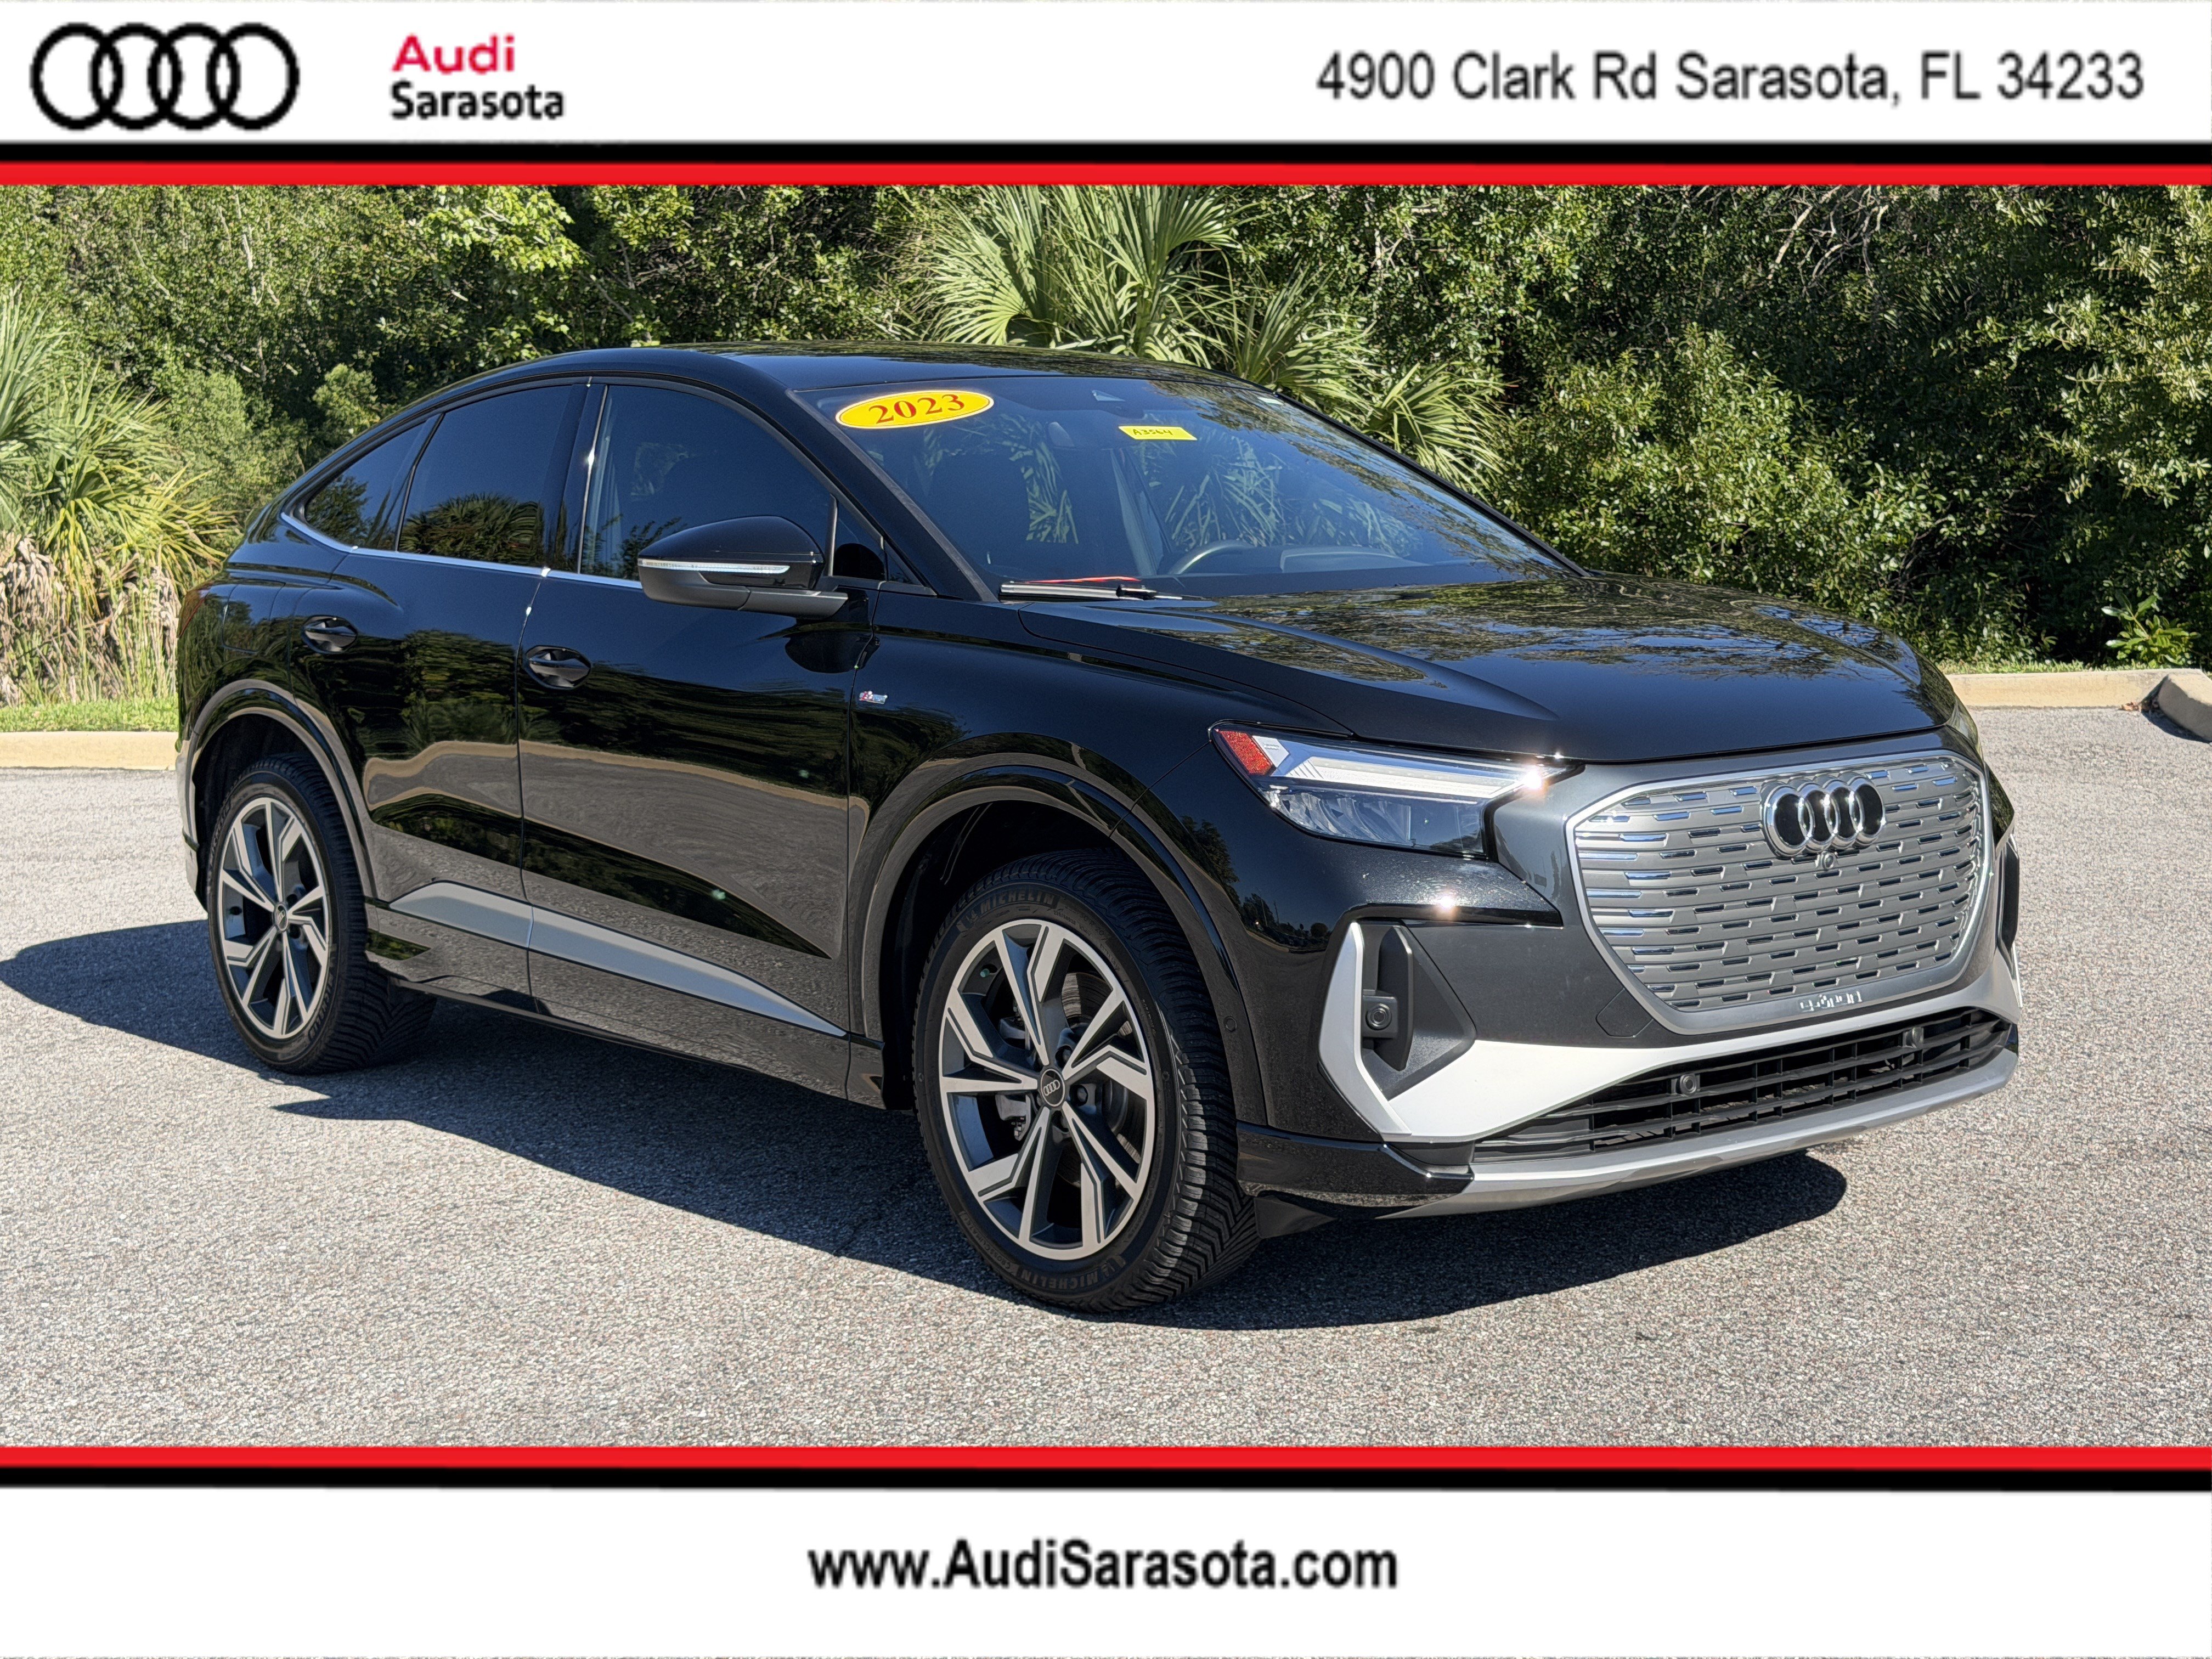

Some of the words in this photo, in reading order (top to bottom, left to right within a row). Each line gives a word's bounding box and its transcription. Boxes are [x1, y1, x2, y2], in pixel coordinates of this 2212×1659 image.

[868, 394, 965, 425] 2023
[980, 887, 1055, 914] MICHELIN
[1020, 1268, 1098, 1290] MICHELIN
